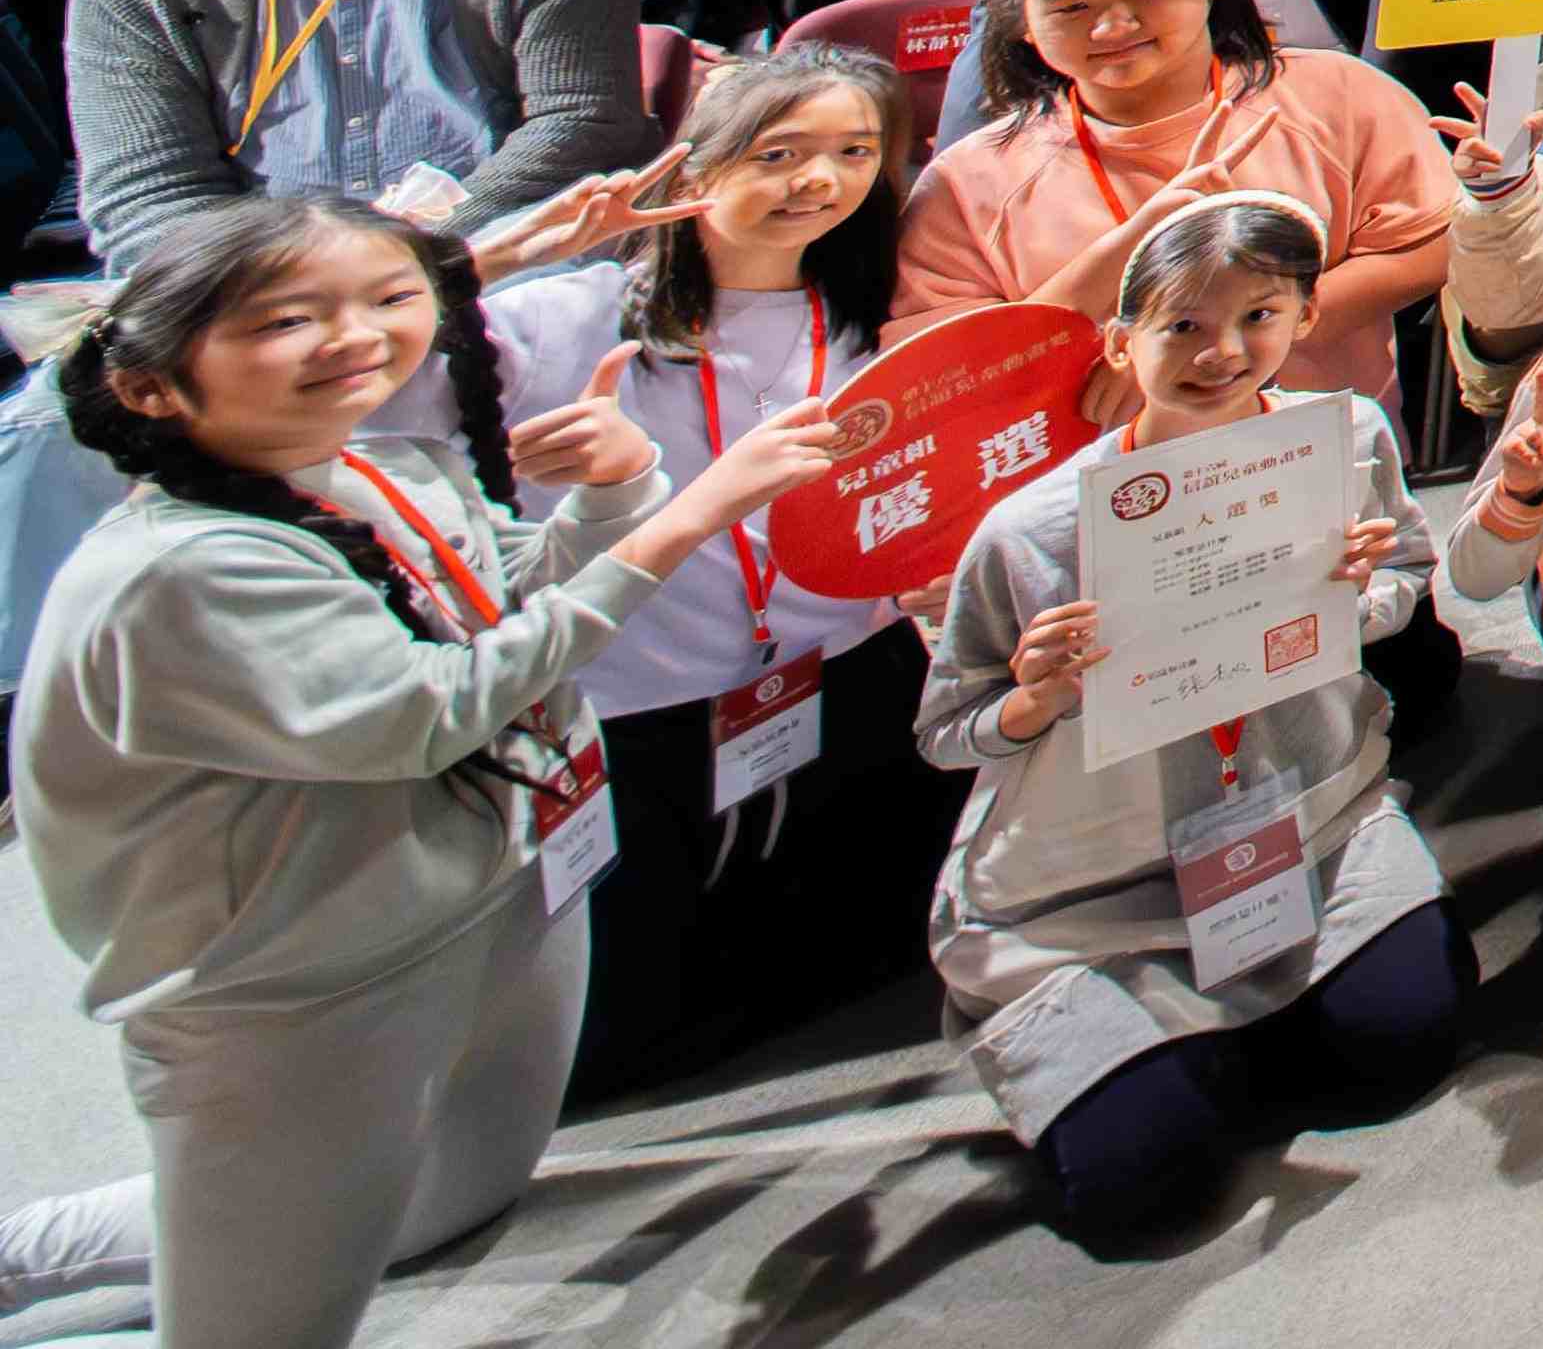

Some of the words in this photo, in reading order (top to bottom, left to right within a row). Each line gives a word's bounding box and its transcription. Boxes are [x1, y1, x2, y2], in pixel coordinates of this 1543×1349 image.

[835, 432, 937, 498] 兒童組
[852, 410, 1054, 555] 優選
